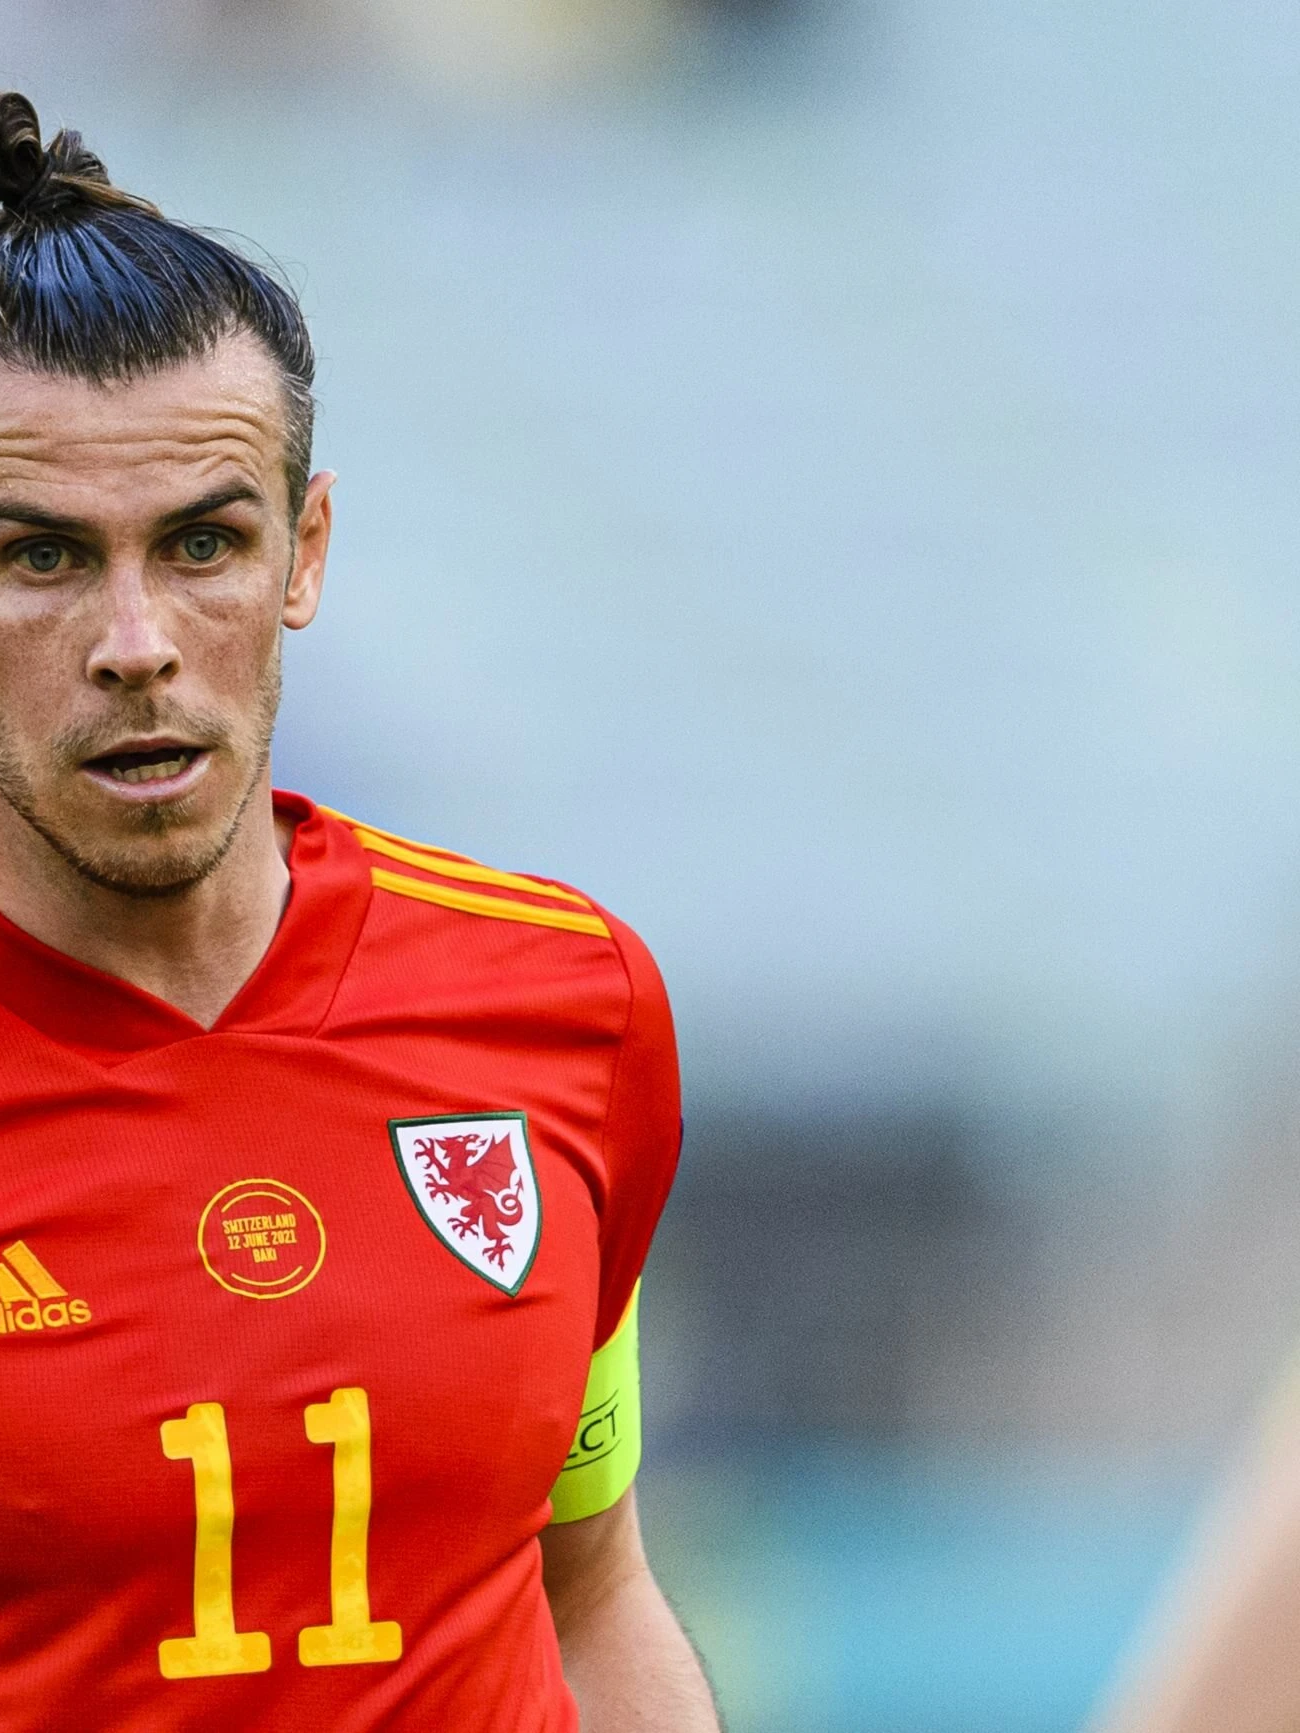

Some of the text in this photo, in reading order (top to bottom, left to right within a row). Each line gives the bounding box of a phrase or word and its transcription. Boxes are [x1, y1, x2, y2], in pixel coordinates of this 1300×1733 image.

[222, 1213, 296, 1234] SWITZERLAND
[228, 1229, 297, 1250] 12 JUNE 2021
[567, 1403, 619, 1459] CT
[158, 1387, 402, 1679] 11
